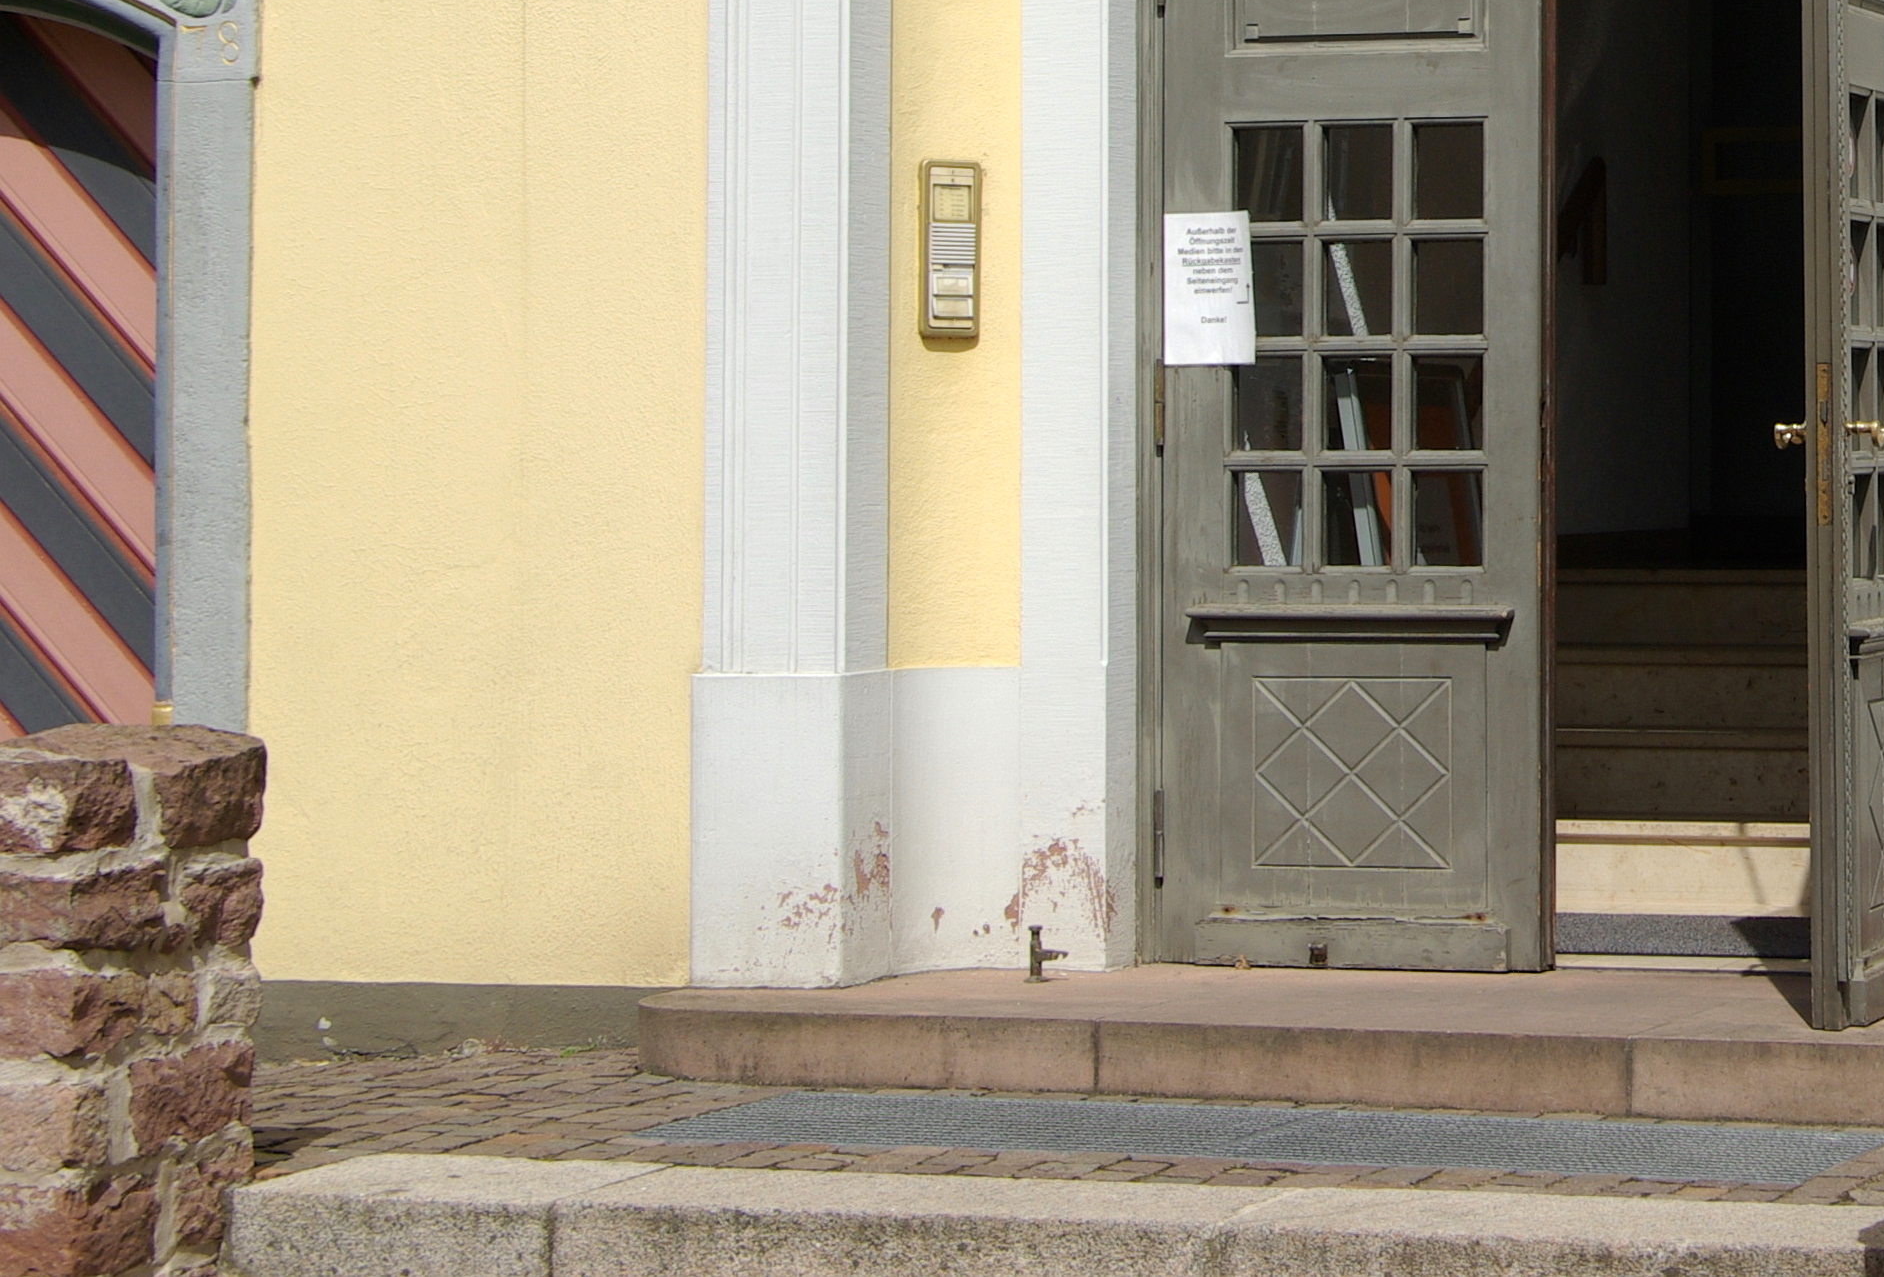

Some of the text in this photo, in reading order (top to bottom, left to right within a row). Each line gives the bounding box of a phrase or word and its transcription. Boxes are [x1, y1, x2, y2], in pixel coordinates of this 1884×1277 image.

[1186, 227, 1225, 235] Außerhalb
[1188, 236, 1235, 246] Öffnungszeit
[1207, 247, 1223, 255] bitte
[1192, 267, 1216, 275] neben
[1200, 315, 1228, 324] Danke!
